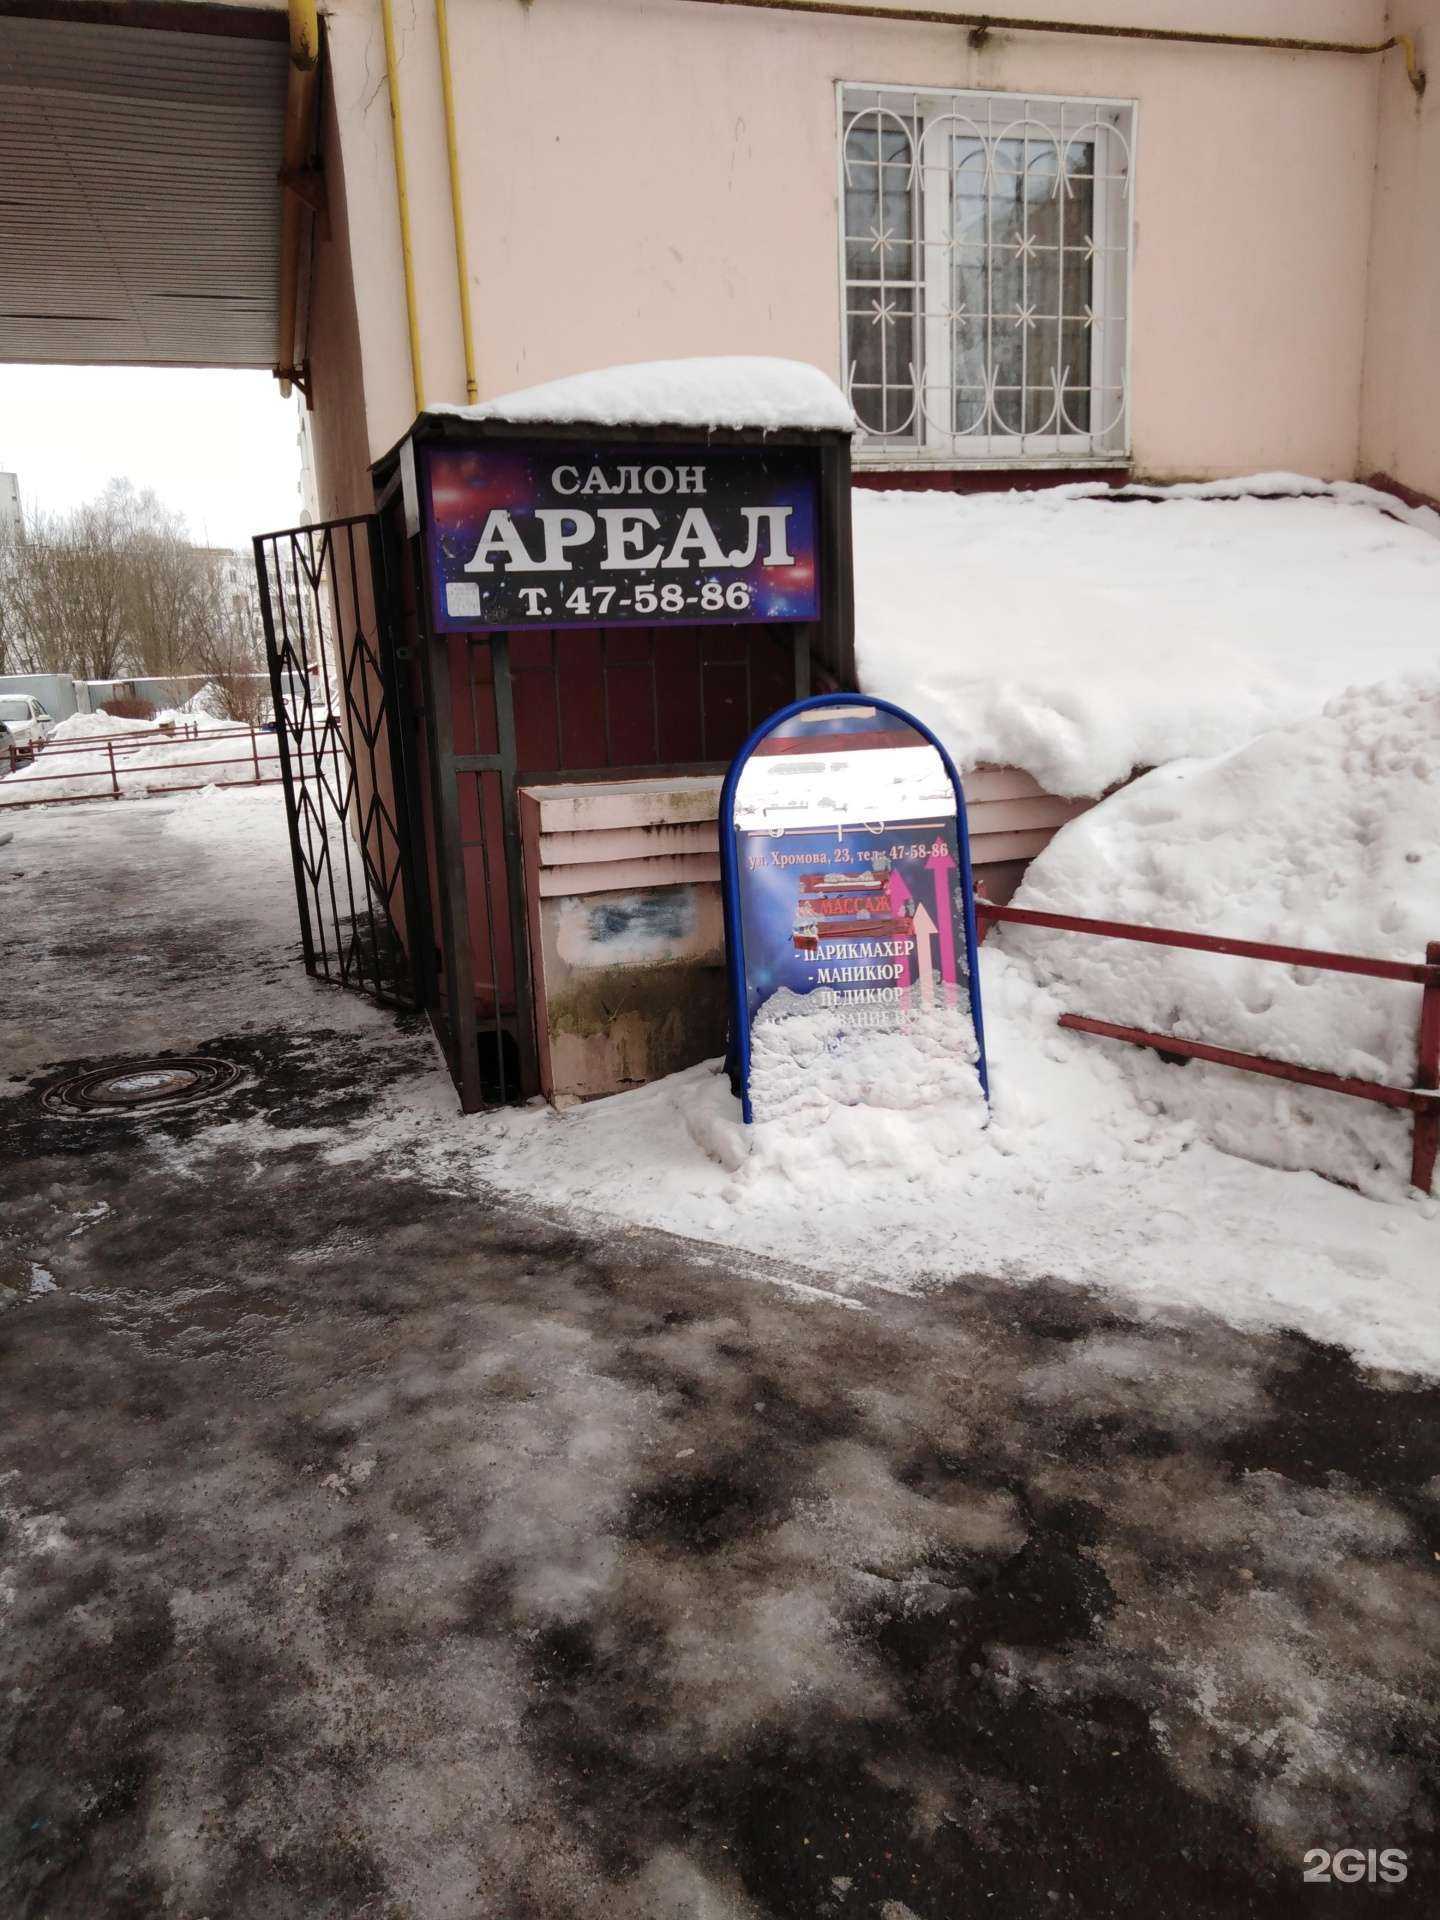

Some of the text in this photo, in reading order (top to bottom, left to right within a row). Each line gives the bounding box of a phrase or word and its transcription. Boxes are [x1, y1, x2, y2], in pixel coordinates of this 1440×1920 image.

[551, 466, 707, 495] САЛОН
[464, 506, 795, 572] АРЕАЛ
[565, 582, 751, 615] 47-58-86
[771, 851, 831, 870] Хромова,
[834, 848, 854, 865] 23,
[889, 843, 949, 860] 47-58-86
[804, 940, 914, 961] ПАРИКМАХЕР
[817, 964, 904, 984] МАНИКЮР
